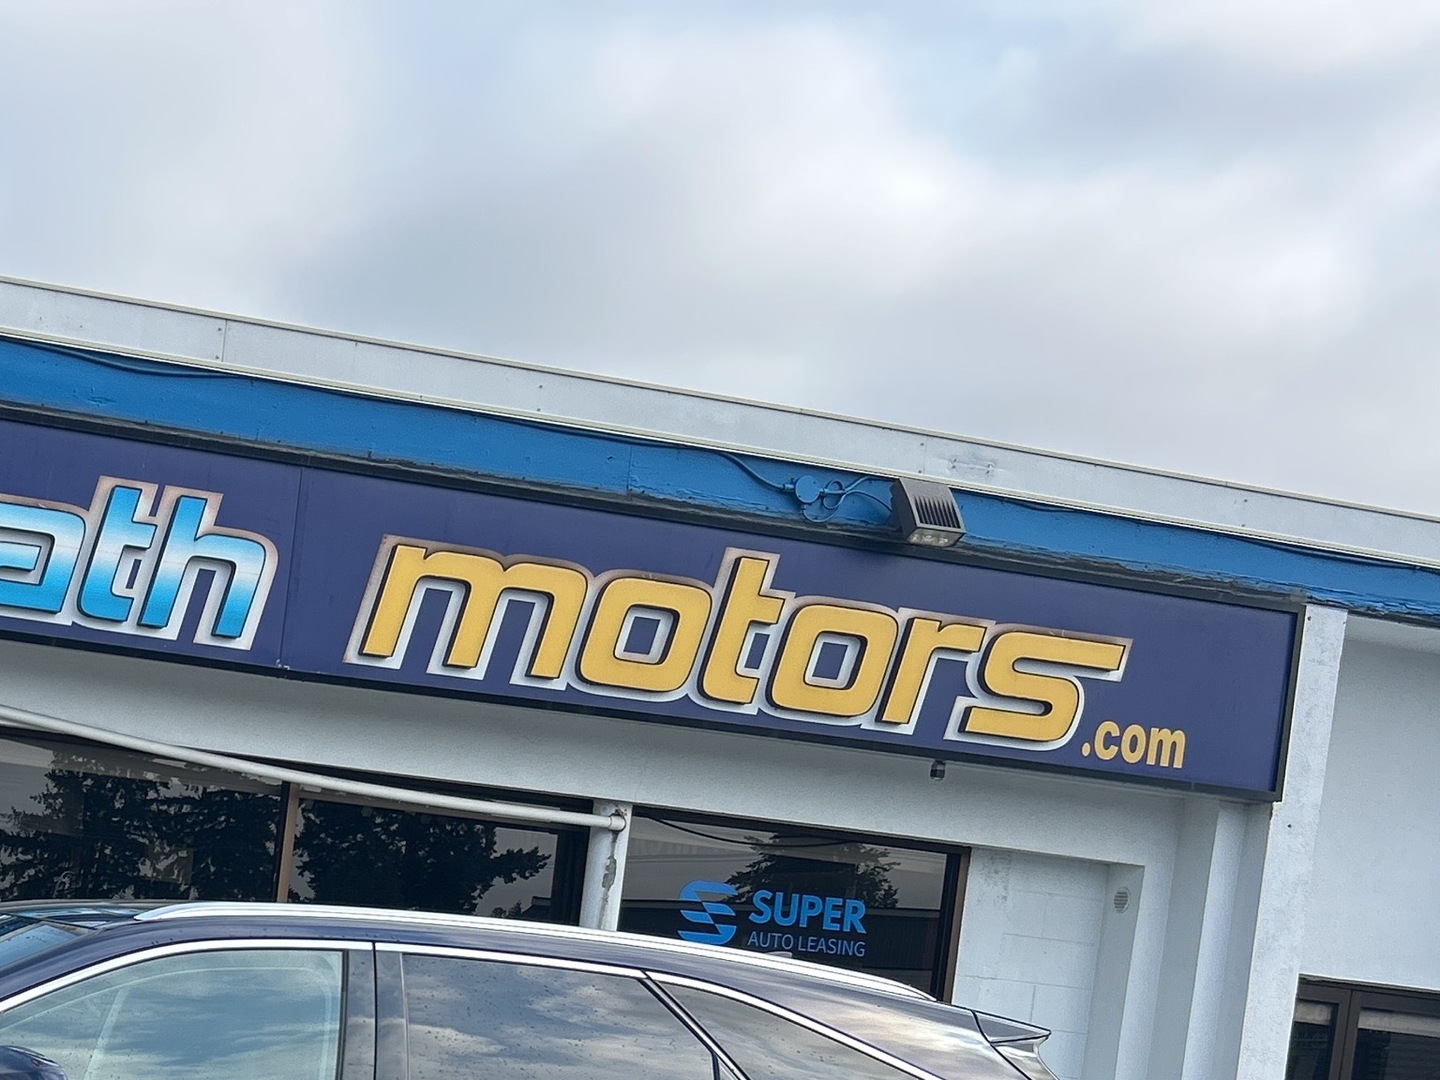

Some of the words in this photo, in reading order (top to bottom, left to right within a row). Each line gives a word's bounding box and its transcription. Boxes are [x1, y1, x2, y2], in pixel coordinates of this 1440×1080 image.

[343, 534, 1132, 751] motors
[1081, 720, 1186, 769] .com
[748, 889, 867, 934] SUPER
[747, 931, 794, 950] AUTO
[798, 936, 866, 957] LEASING
